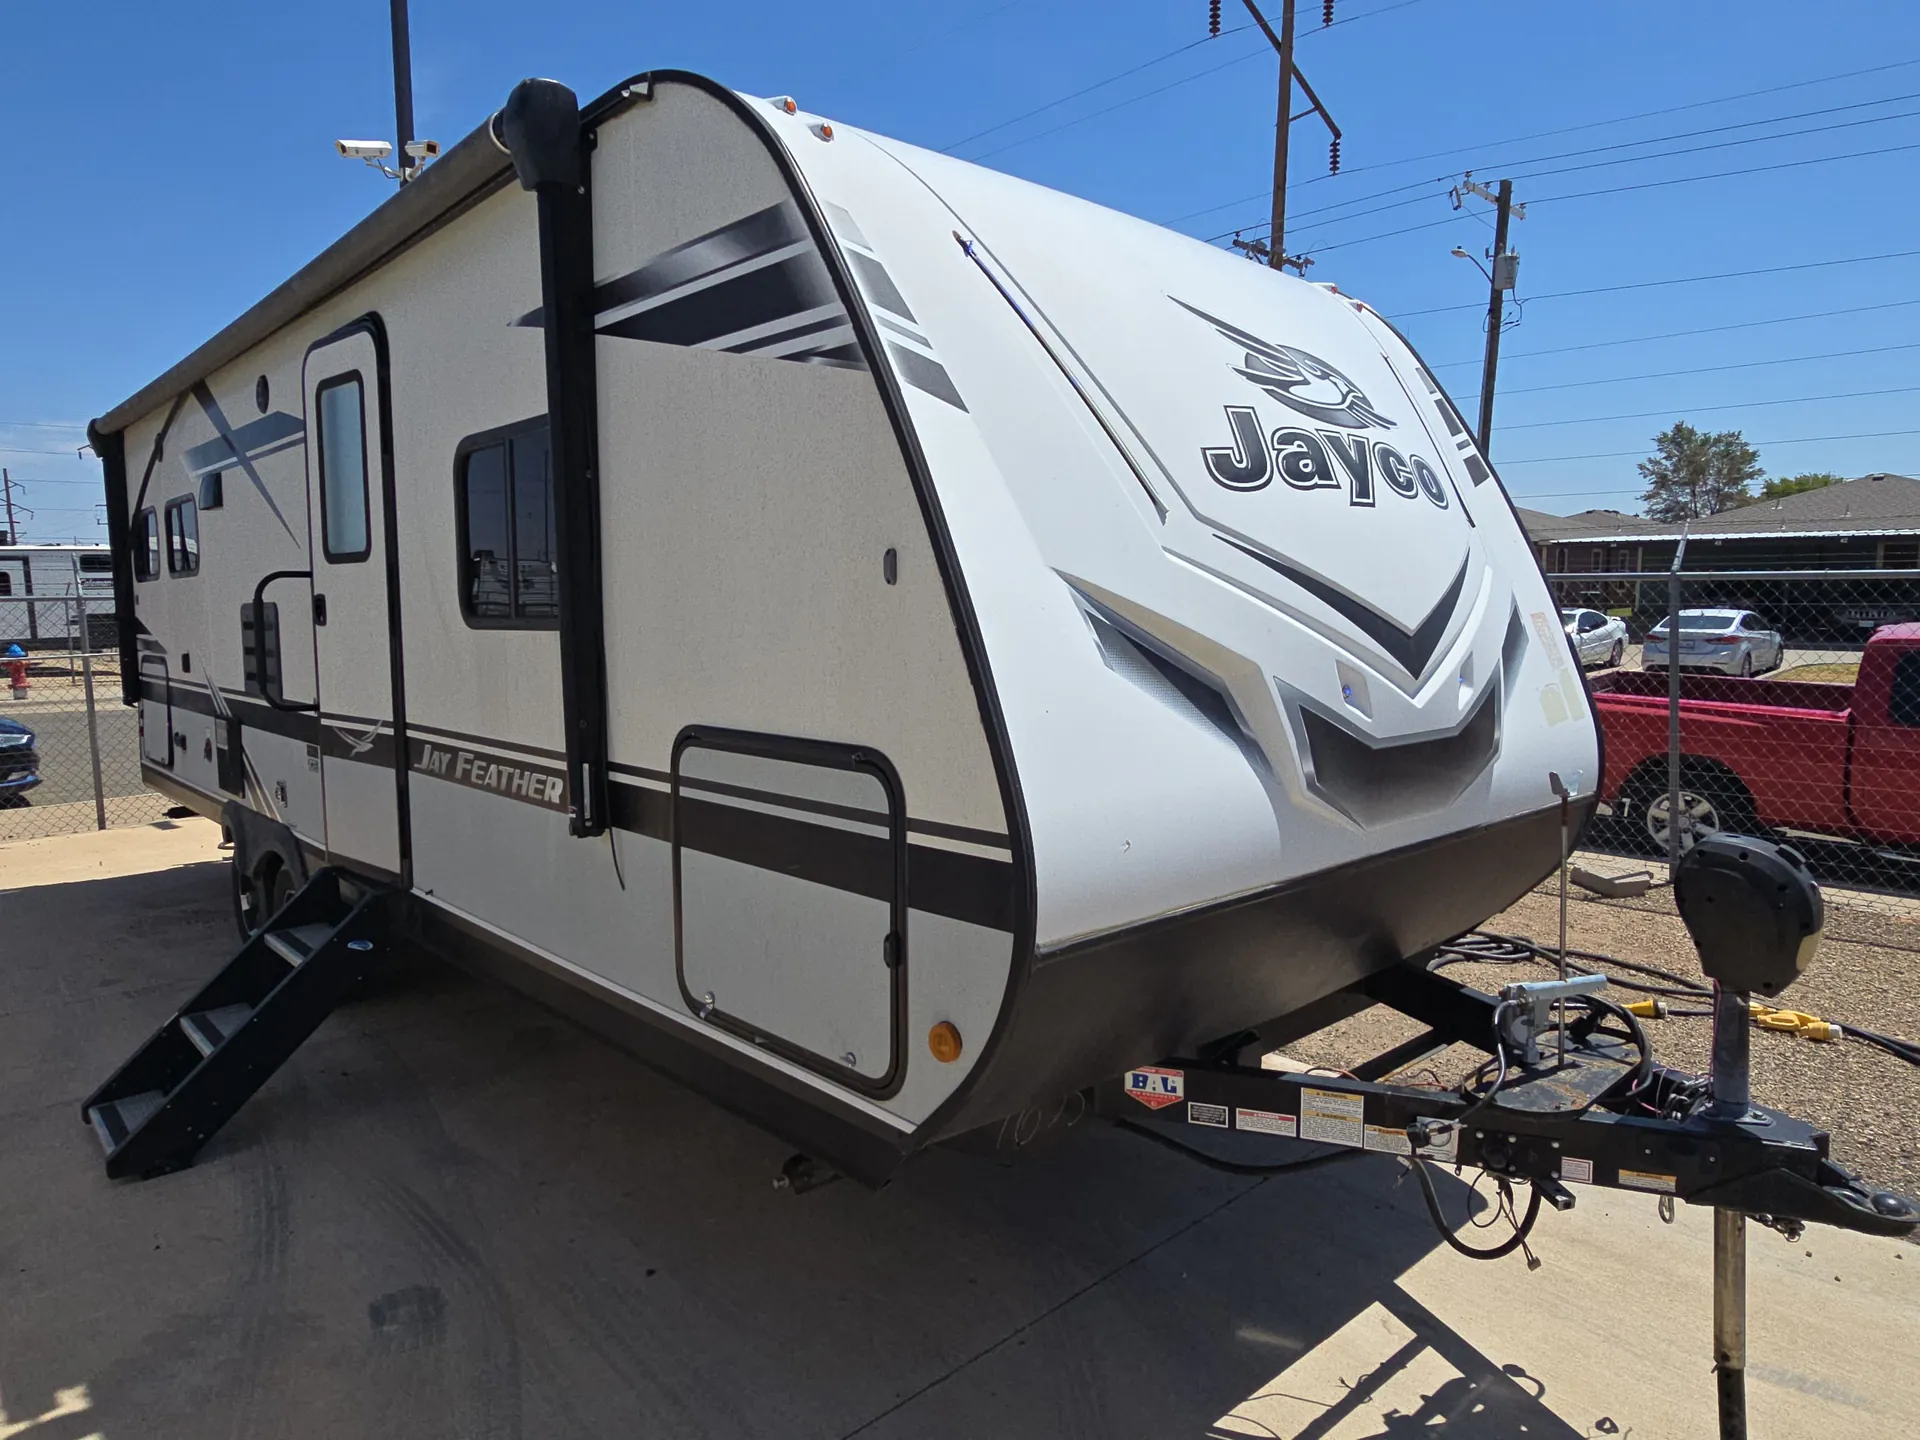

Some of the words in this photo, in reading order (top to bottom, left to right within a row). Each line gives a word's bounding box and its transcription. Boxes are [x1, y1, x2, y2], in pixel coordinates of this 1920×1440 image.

[1200, 405, 1449, 510] Jayco
[414, 744, 452, 776] JAY
[455, 751, 565, 804] FEATHER
[1132, 1073, 1178, 1094] BAL
